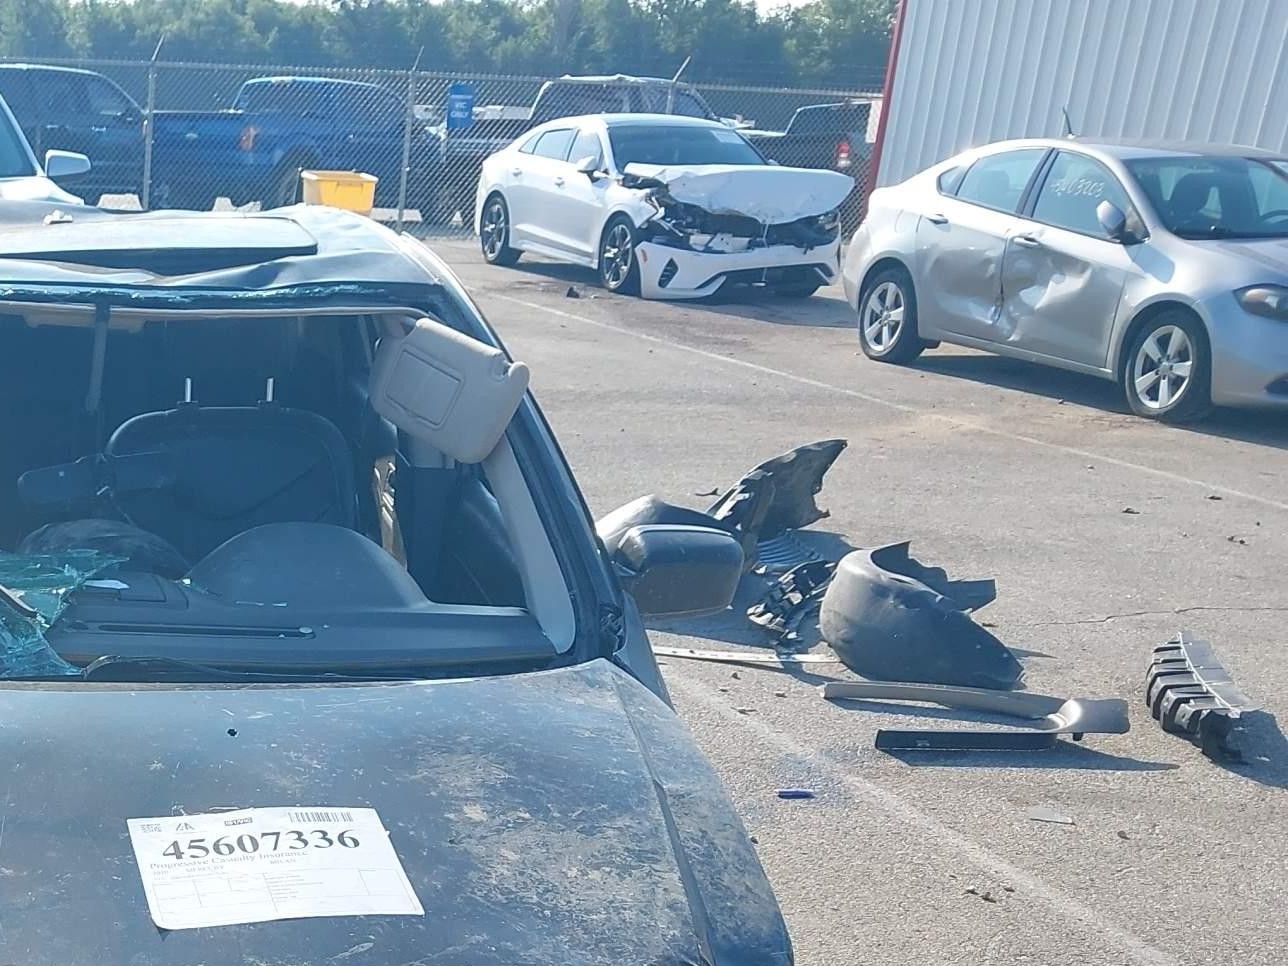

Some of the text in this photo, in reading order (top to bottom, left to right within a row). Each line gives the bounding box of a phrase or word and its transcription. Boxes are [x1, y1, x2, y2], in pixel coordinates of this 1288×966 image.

[162, 829, 360, 860] 45607336
[150, 850, 310, 870] Progressive Casualty Insurance
